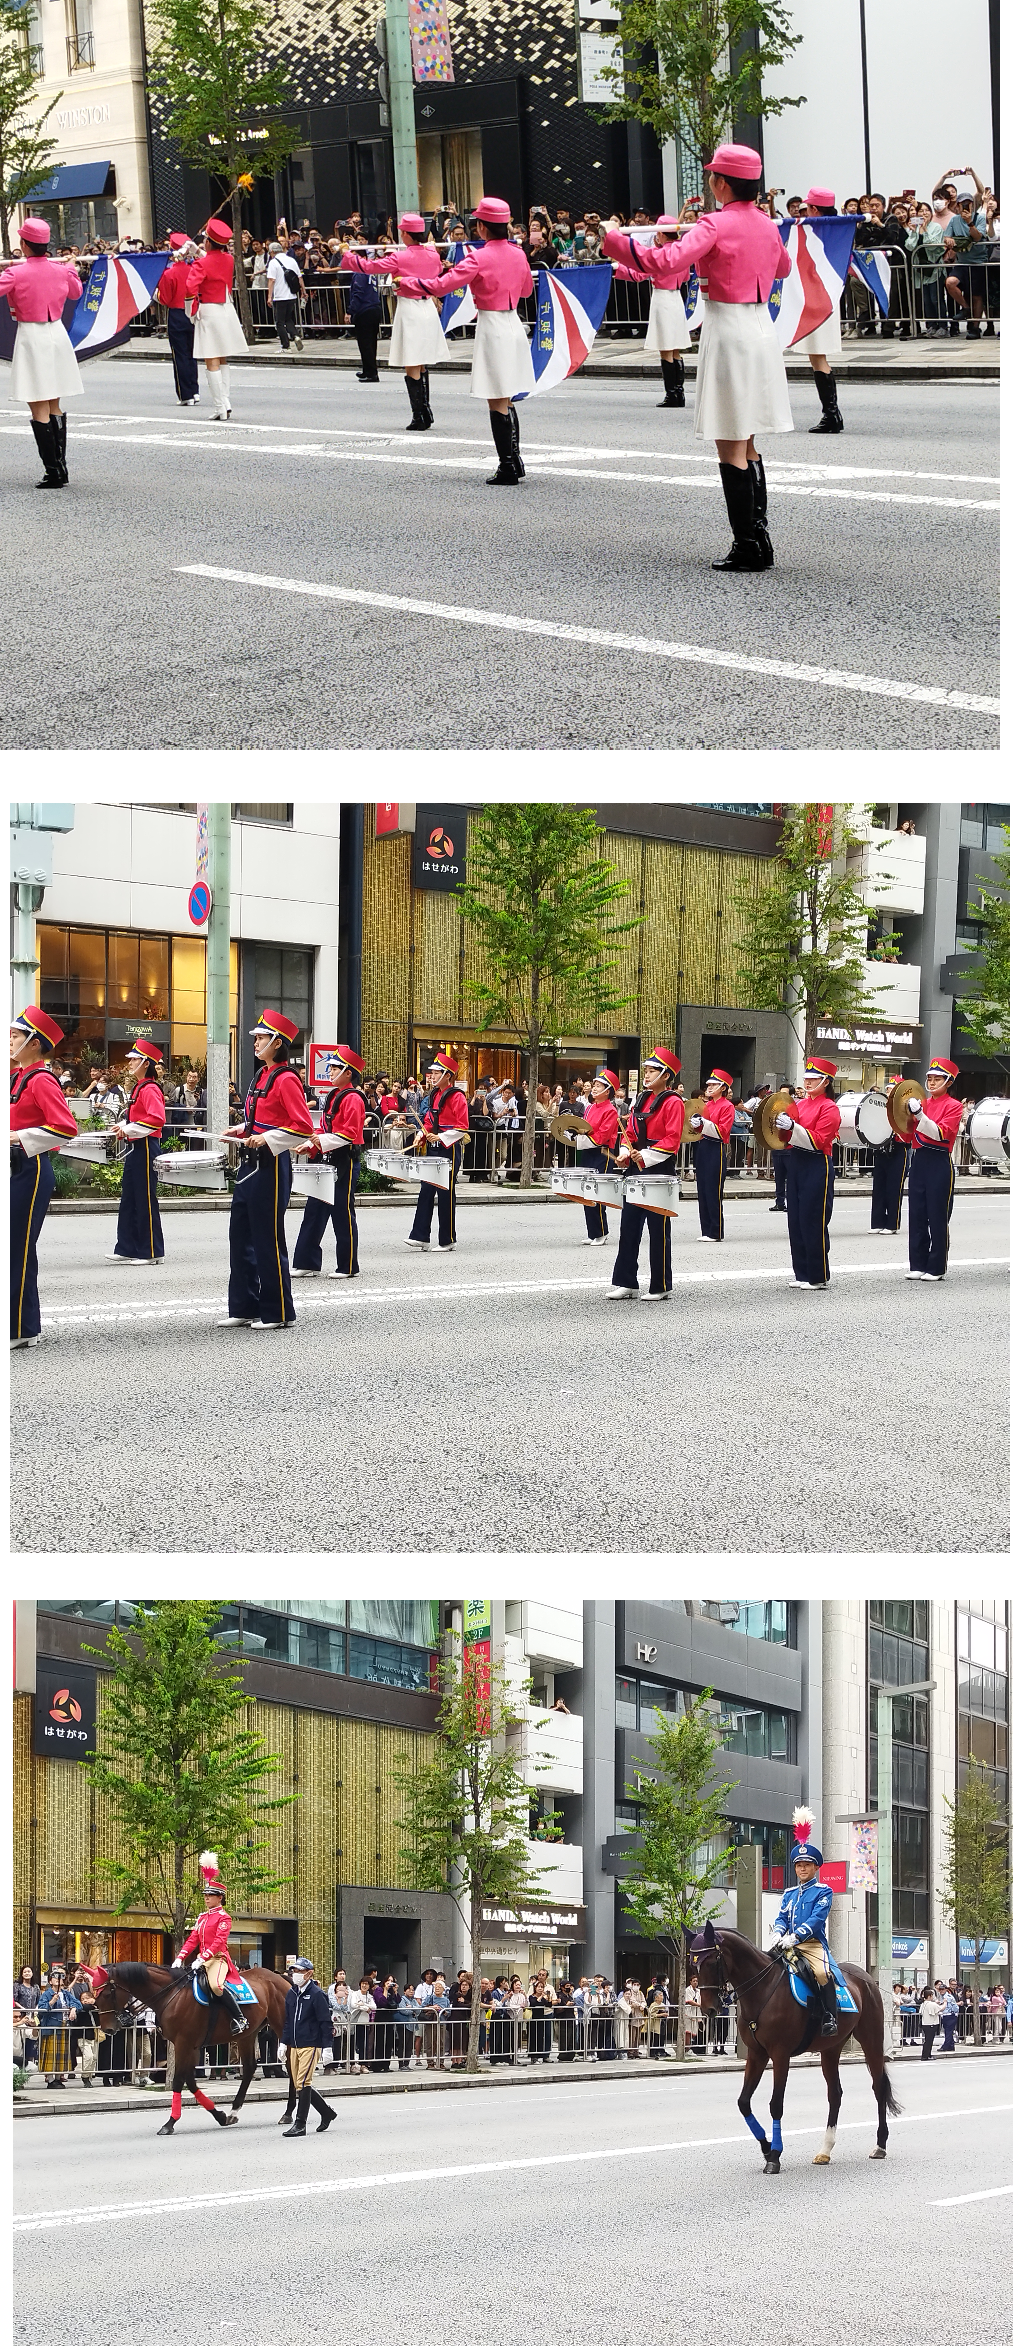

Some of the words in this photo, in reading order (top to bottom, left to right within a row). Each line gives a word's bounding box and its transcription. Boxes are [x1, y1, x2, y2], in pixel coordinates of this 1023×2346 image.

[56, 103, 111, 130] WINSTON
[422, 861, 459, 874] はせがわ
[854, 1029, 884, 1042] Watch
[885, 1031, 913, 1045] World
[44, 1725, 88, 1741] はせがわ
[520, 1910, 551, 1924] Watch
[551, 1912, 578, 1926] World
